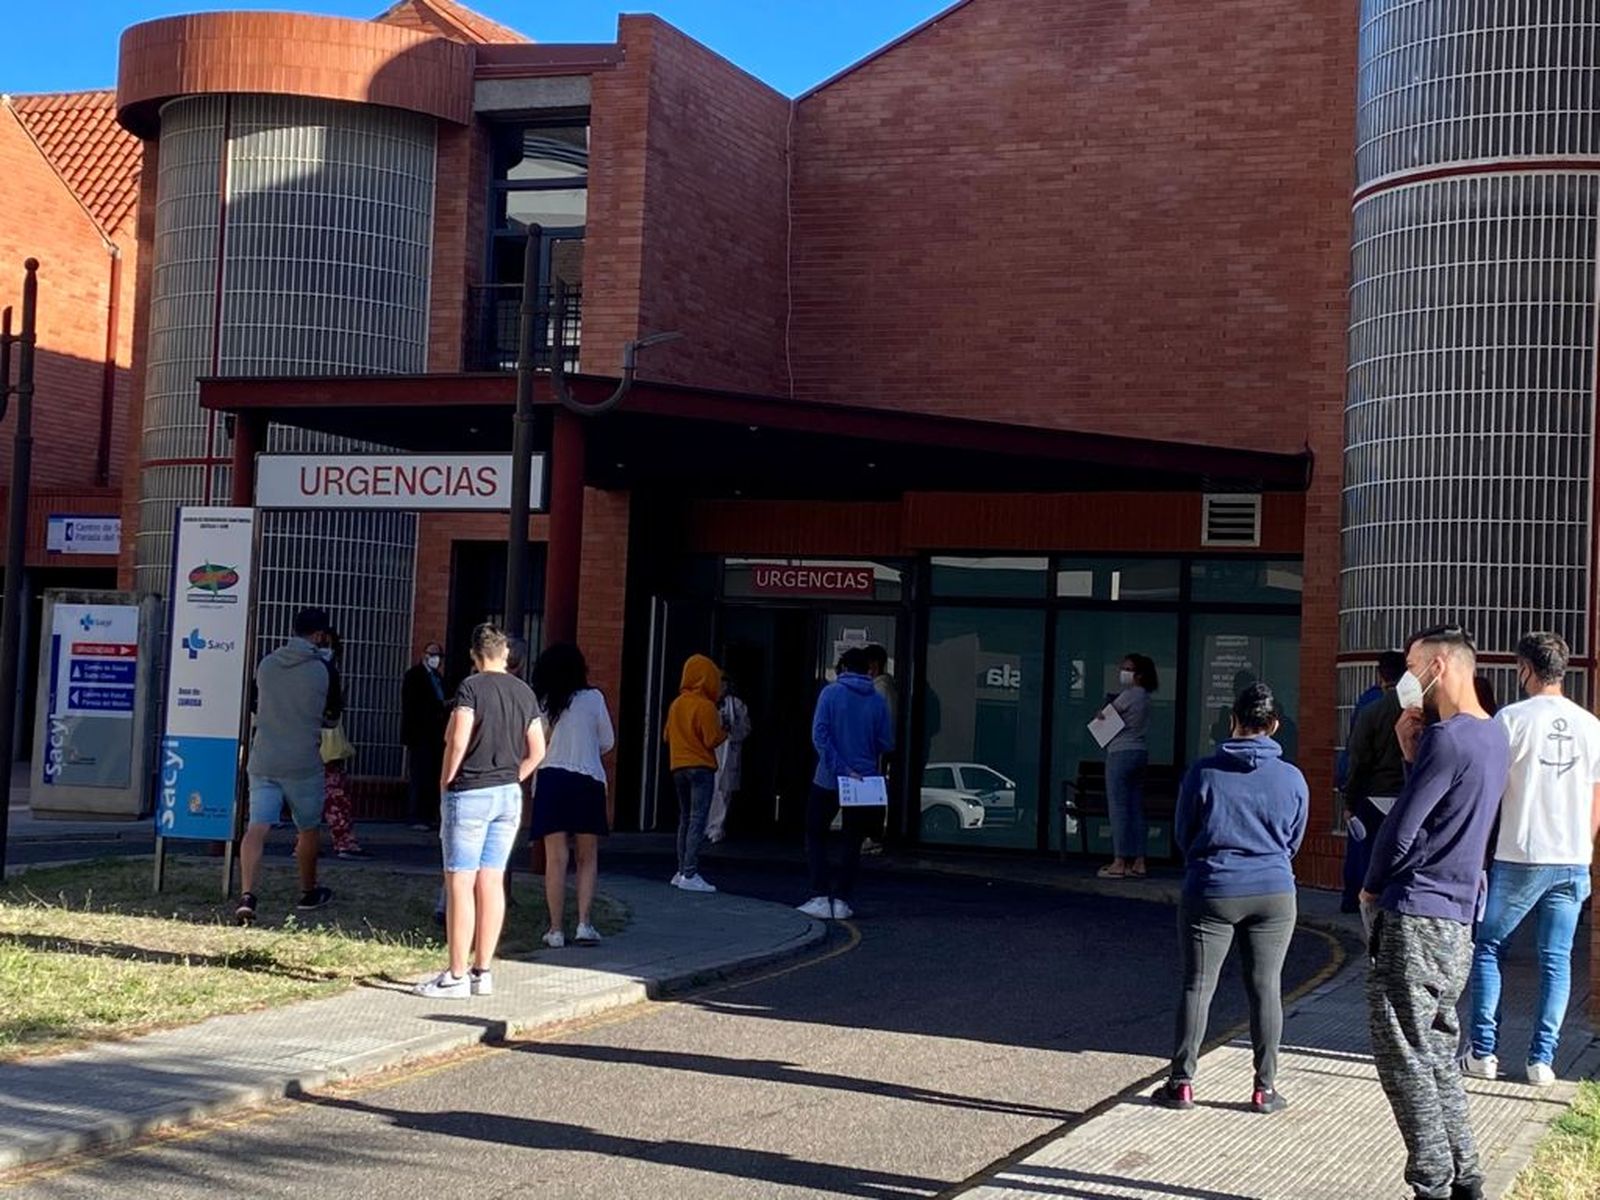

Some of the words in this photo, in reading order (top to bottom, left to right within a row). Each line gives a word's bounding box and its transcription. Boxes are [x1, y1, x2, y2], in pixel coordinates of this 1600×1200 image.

[300, 466, 497, 496] URGENCIAS
[75, 523, 101, 531] Centro
[757, 570, 869, 589] URGENCIAS
[208, 639, 235, 653] Sacyl
[46, 713, 69, 776] Sacyl
[158, 740, 184, 829] Sacyl
